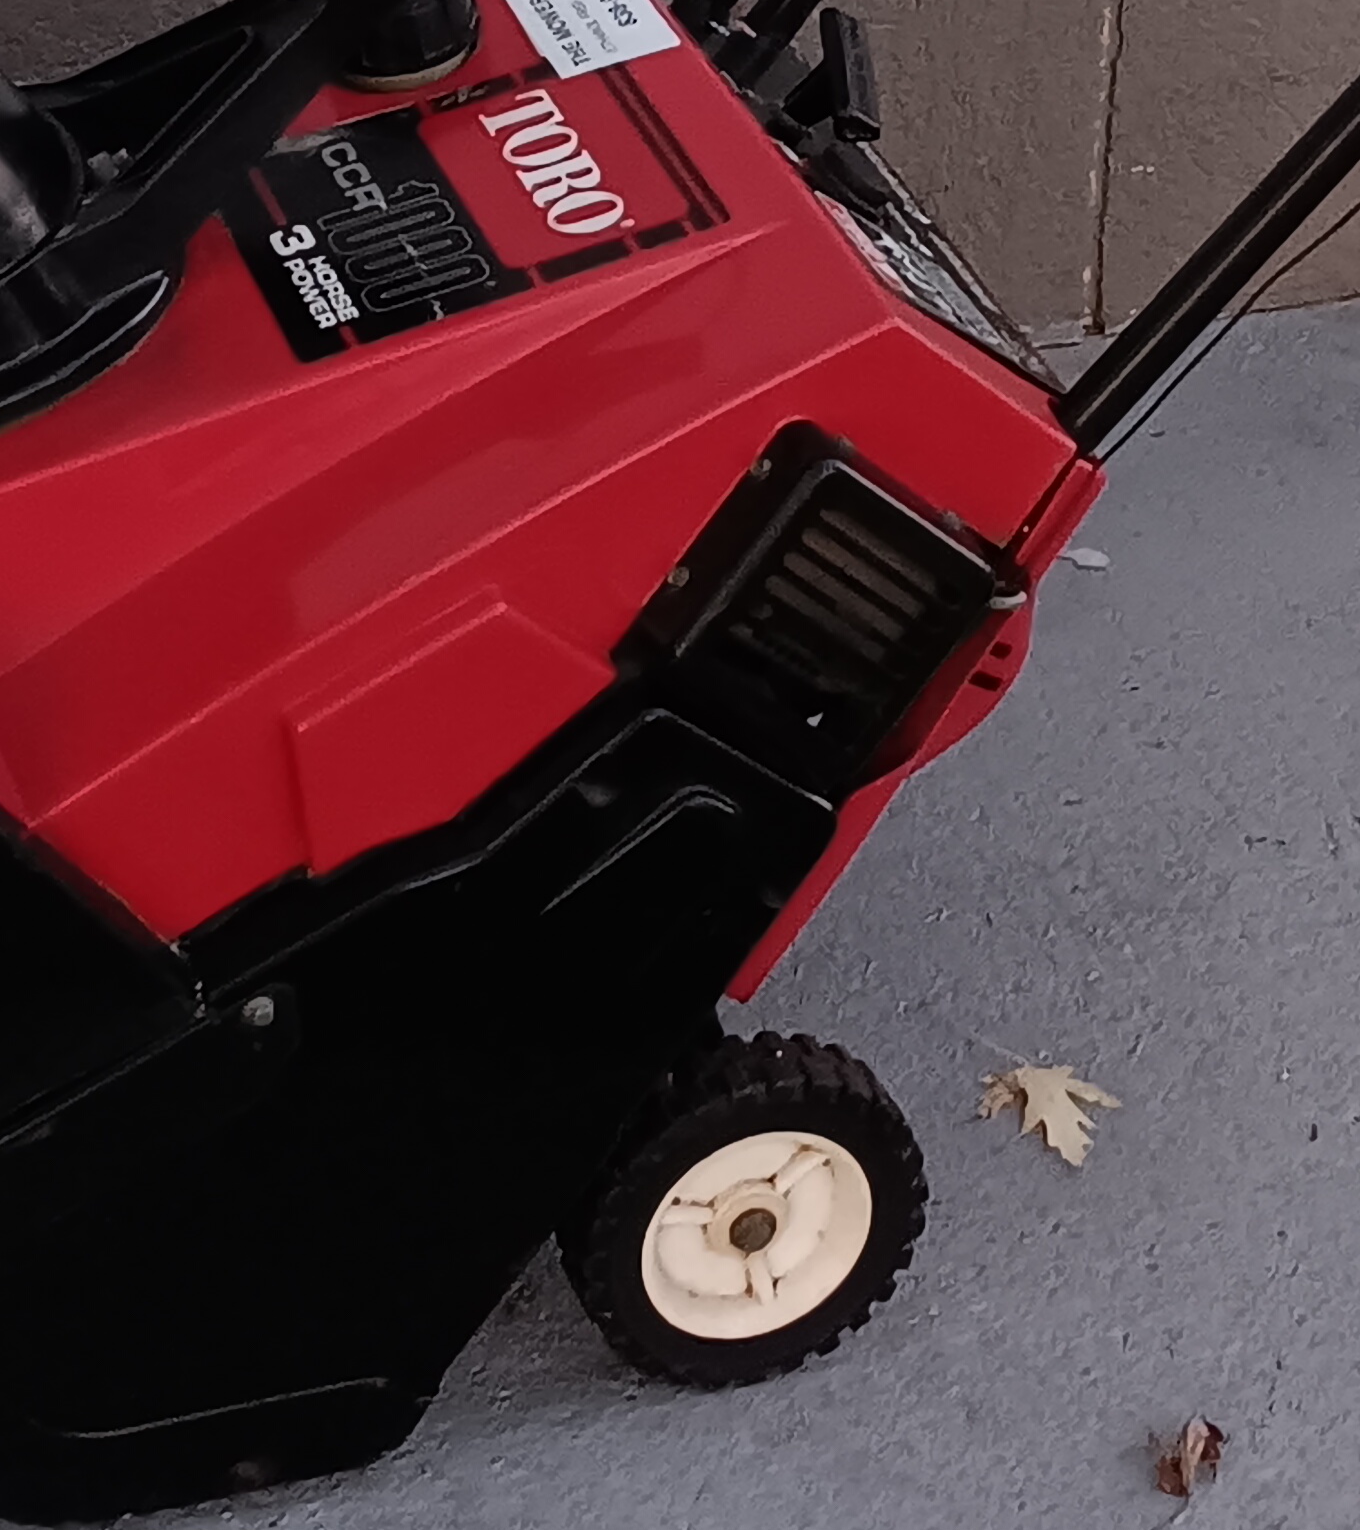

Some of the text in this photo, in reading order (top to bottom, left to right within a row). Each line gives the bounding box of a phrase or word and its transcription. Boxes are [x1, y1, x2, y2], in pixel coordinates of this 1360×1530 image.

[478, 88, 625, 234] TORO
[269, 224, 361, 323] 3 HORSE
[282, 257, 338, 330] POWER
[316, 180, 491, 313] 1000
